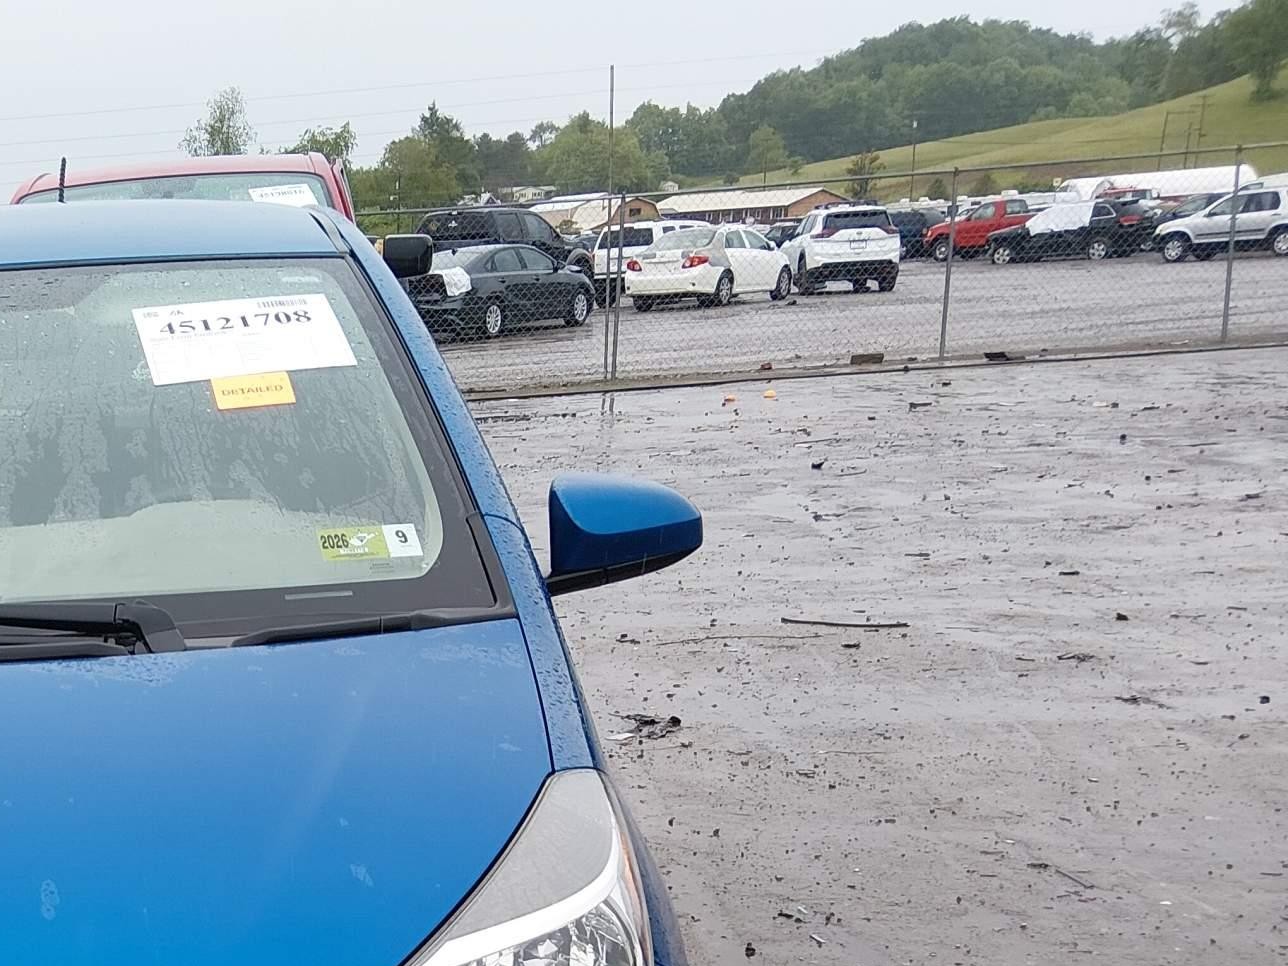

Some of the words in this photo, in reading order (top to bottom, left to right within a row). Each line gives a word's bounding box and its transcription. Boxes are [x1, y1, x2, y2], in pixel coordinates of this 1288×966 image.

[159, 308, 312, 335] 45121708
[221, 384, 284, 396] DETAILED
[320, 533, 350, 549] 2026
[395, 529, 409, 544] 9
